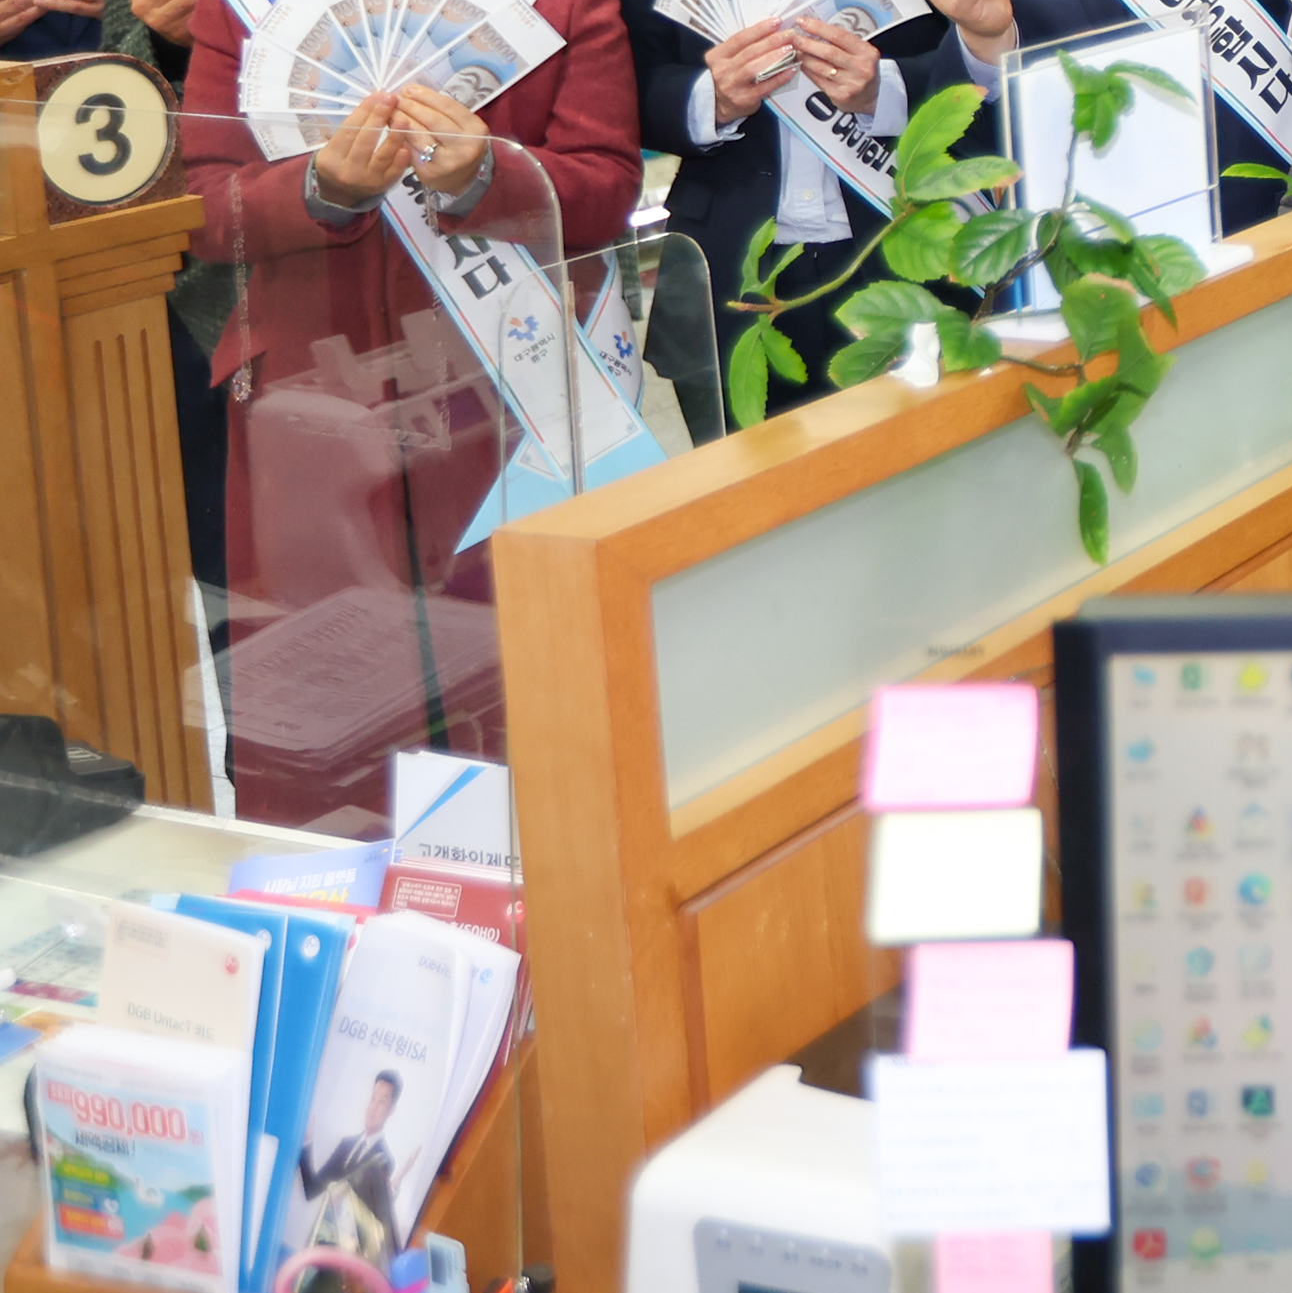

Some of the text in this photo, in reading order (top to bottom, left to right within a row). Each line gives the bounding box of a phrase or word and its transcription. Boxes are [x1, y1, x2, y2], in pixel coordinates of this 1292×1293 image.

[75, 93, 132, 176] 3
[514, 333, 556, 362] 대구광역시
[127, 1002, 151, 1021] DGB
[339, 1016, 369, 1040] DGB
[72, 1089, 187, 1142] 990,000
